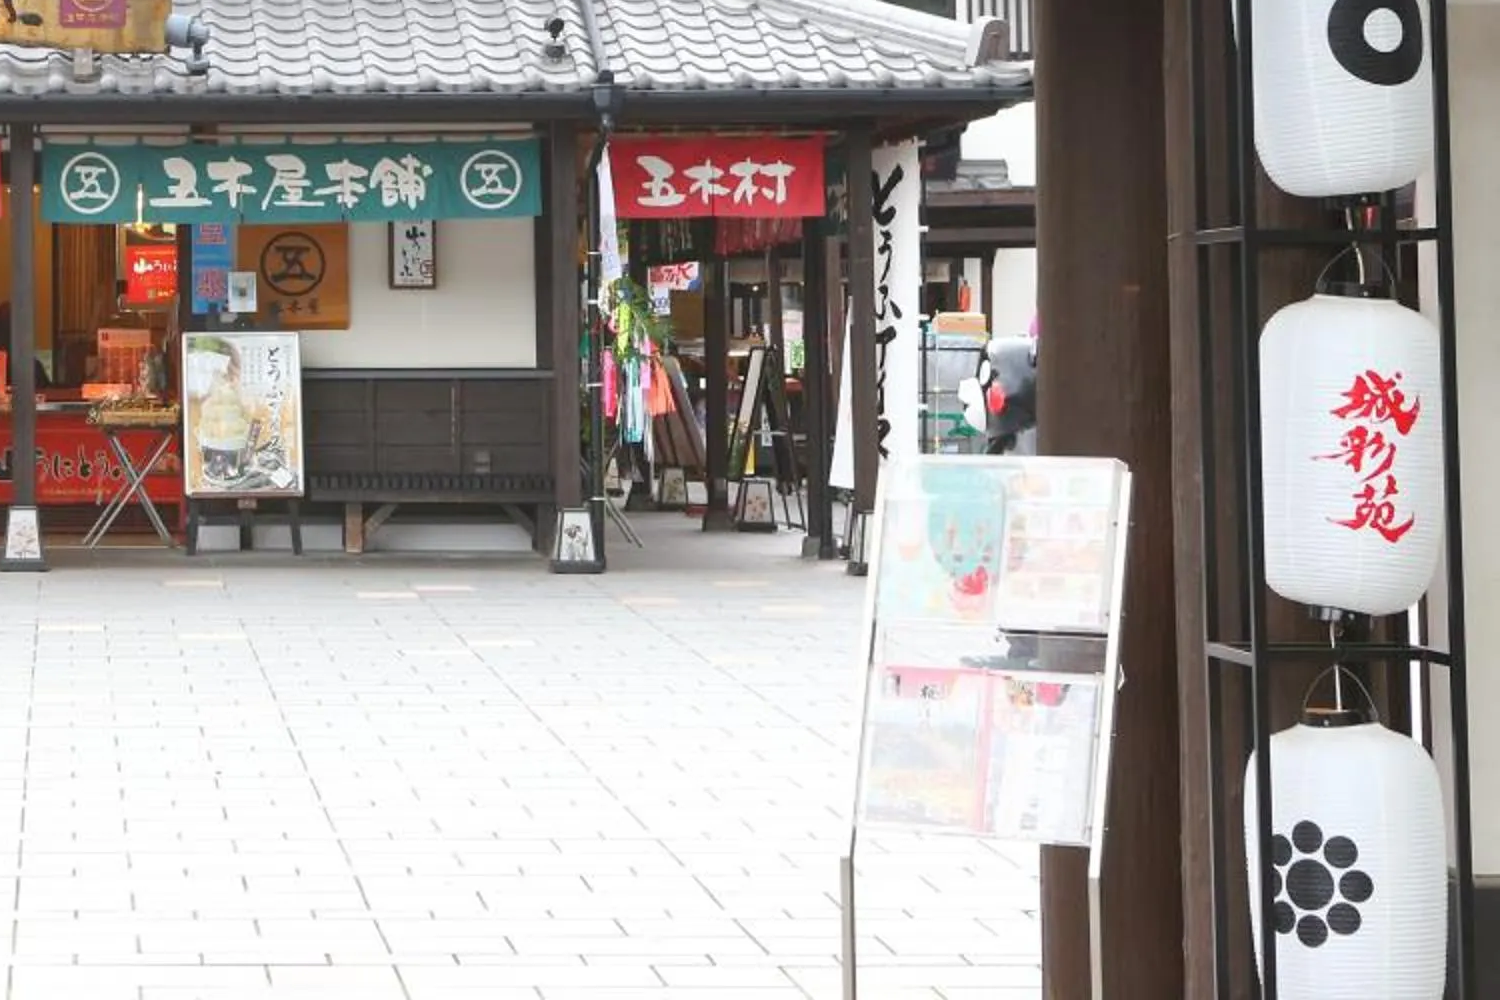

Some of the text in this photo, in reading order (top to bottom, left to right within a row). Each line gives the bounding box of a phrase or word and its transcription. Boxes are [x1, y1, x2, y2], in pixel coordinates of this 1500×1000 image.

[149, 154, 433, 211] 五木屋本舗
[636, 155, 796, 207] 五木村
[1311, 370, 1421, 544] 城彩苑
